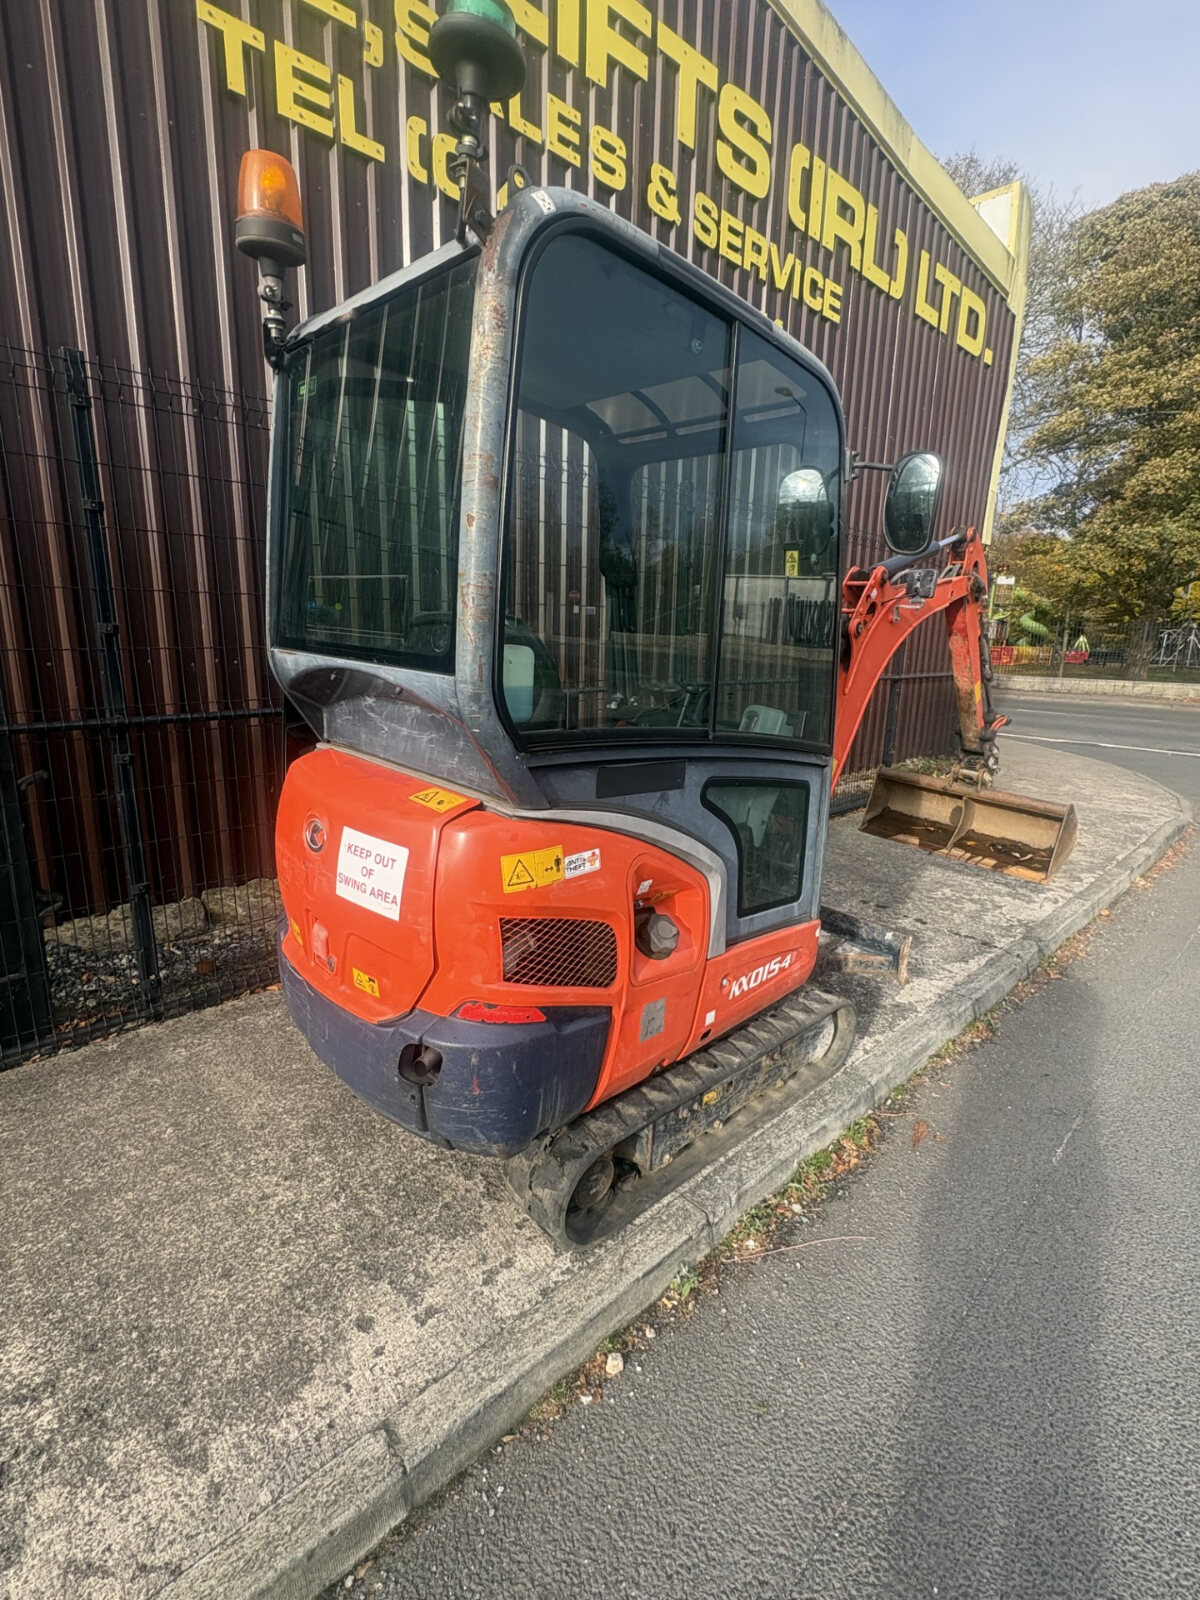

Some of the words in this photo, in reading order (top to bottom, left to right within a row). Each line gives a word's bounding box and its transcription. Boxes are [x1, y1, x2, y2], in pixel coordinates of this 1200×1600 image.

[196, 0, 386, 163] TEL
[647, 162, 681, 227] &
[694, 191, 843, 325] SERVICE
[914, 249, 993, 366] LTD.
[346, 842, 372, 860] KEEP
[374, 853, 397, 870] OUT
[360, 866, 375, 879] OF
[565, 862, 586, 872] THEFT
[337, 872, 367, 894] SWING
[369, 886, 399, 907] AREA
